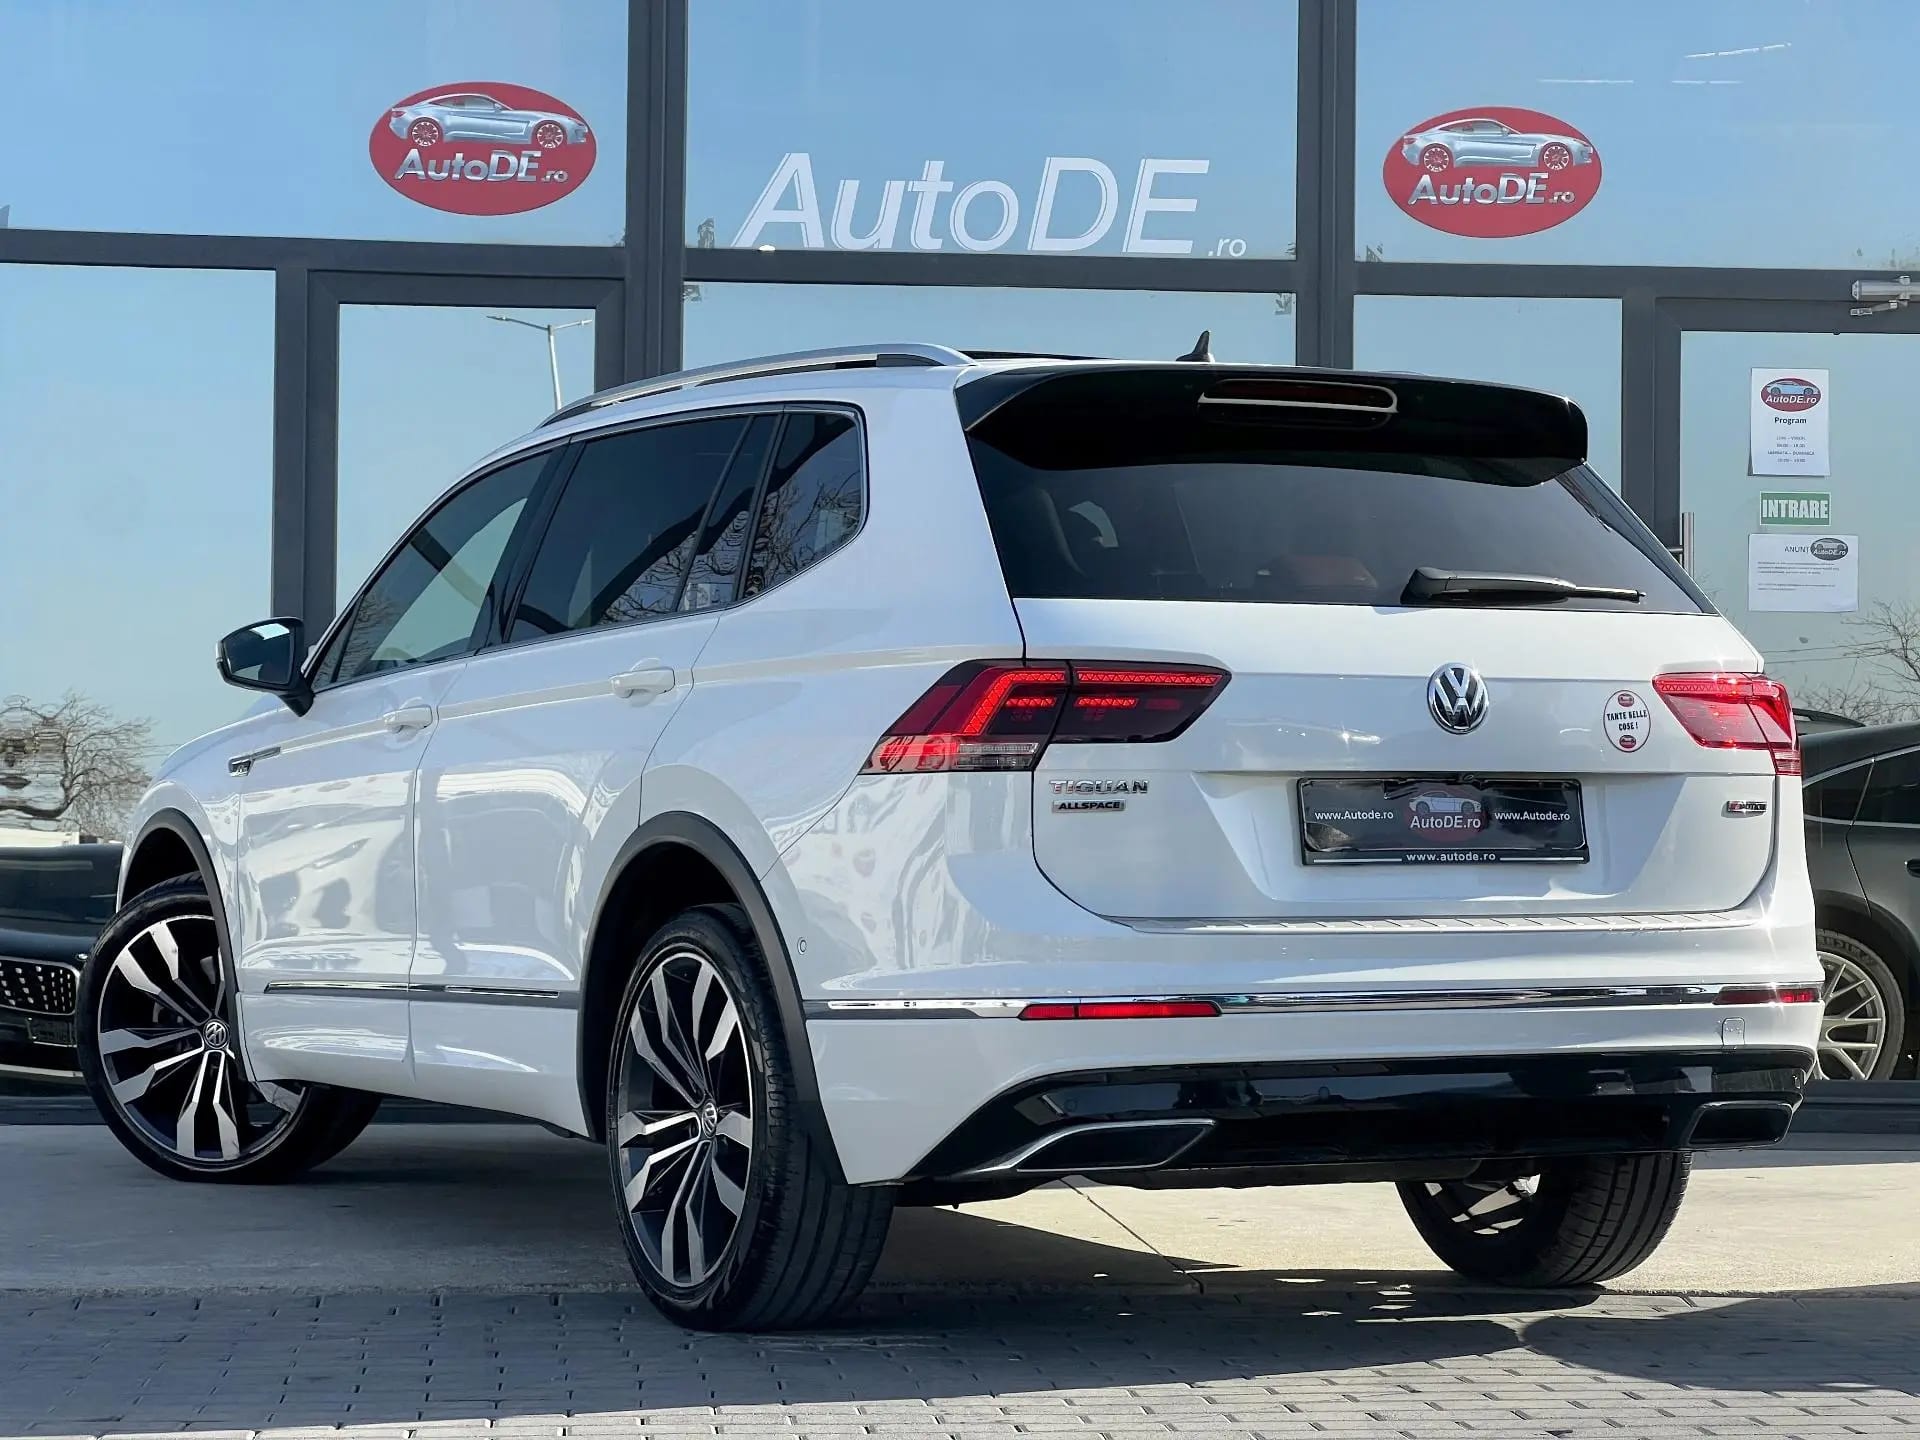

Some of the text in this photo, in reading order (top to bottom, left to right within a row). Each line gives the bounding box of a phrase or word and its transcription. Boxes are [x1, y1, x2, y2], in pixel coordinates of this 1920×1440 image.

[1774, 417, 1807, 425] Program
[1762, 499, 1828, 518] INTRARE
[1607, 711, 1626, 720] TANTE
[1618, 723, 1635, 731] COSE
[1050, 780, 1149, 794] TIGUAN
[1058, 802, 1121, 810] ALLSPACE
[1314, 810, 1394, 820] www.Autode.ro
[1494, 811, 1571, 821] www.Autode.ro
[1410, 815, 1482, 829] AutoDE.ro
[1406, 851, 1496, 861] www.autode.ro
